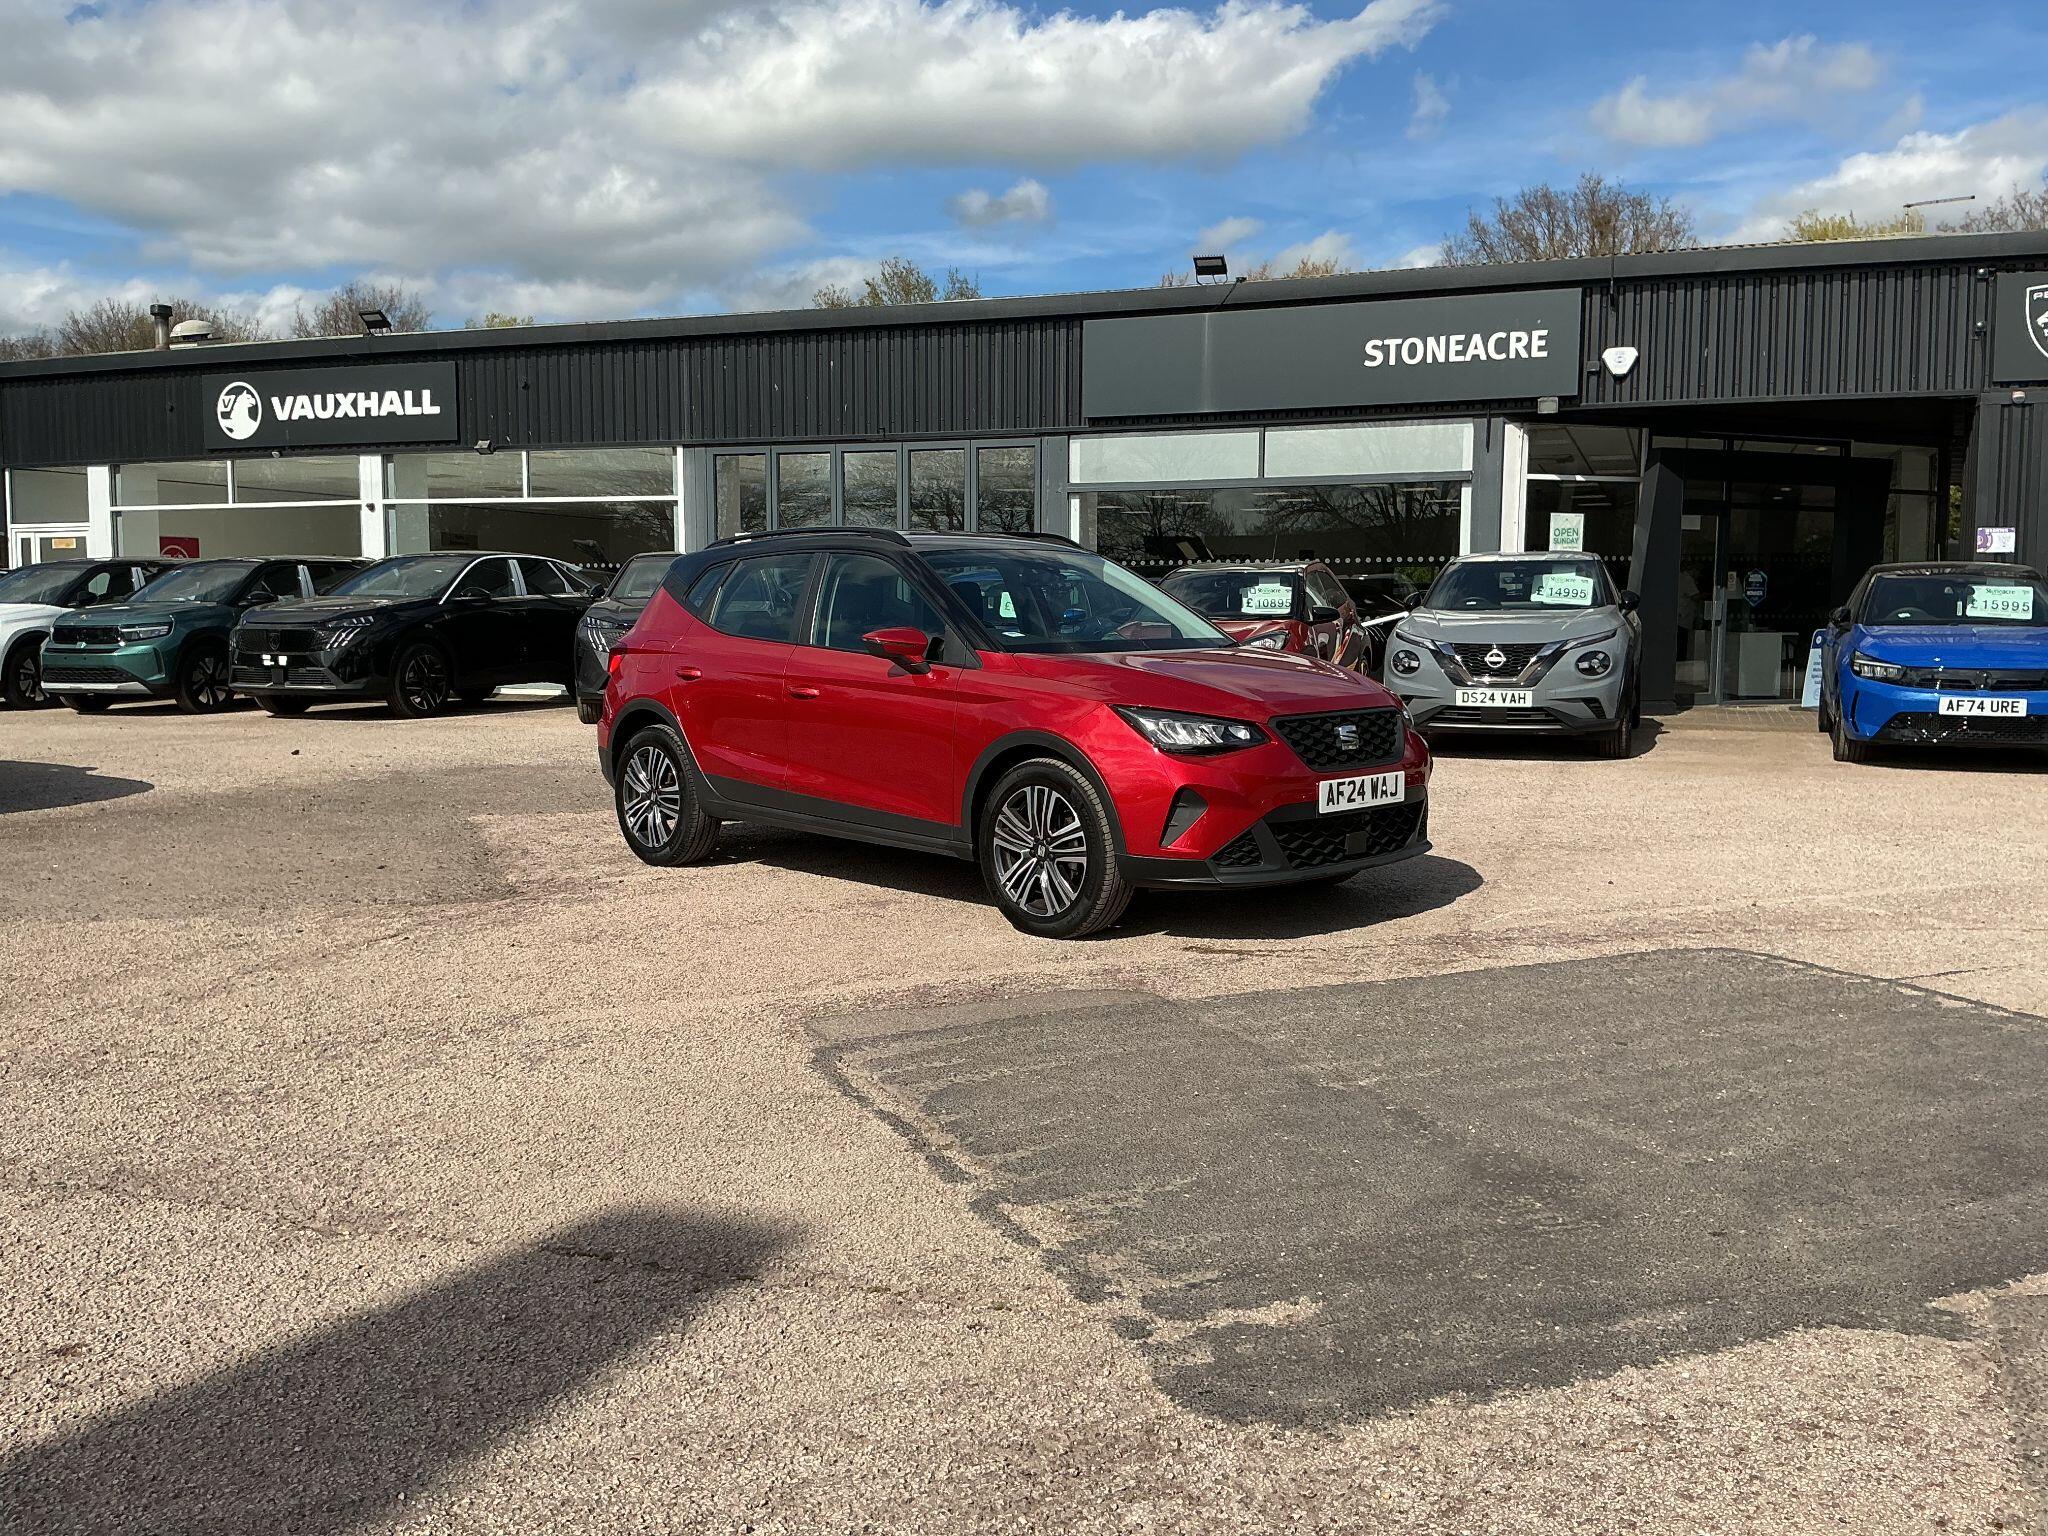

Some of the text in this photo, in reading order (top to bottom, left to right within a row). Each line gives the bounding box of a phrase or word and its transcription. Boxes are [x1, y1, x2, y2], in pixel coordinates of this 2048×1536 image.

[1363, 329, 1549, 367] STONEACRE
[271, 389, 441, 421] VAUXHALL
[1553, 527, 1579, 537] OPEN
[1553, 537, 1579, 545] SUNDAY
[1461, 691, 1526, 704] DS24 VAH
[1946, 699, 2020, 713] AF74 URE
[1326, 774, 1399, 807] AF24 WAJ
